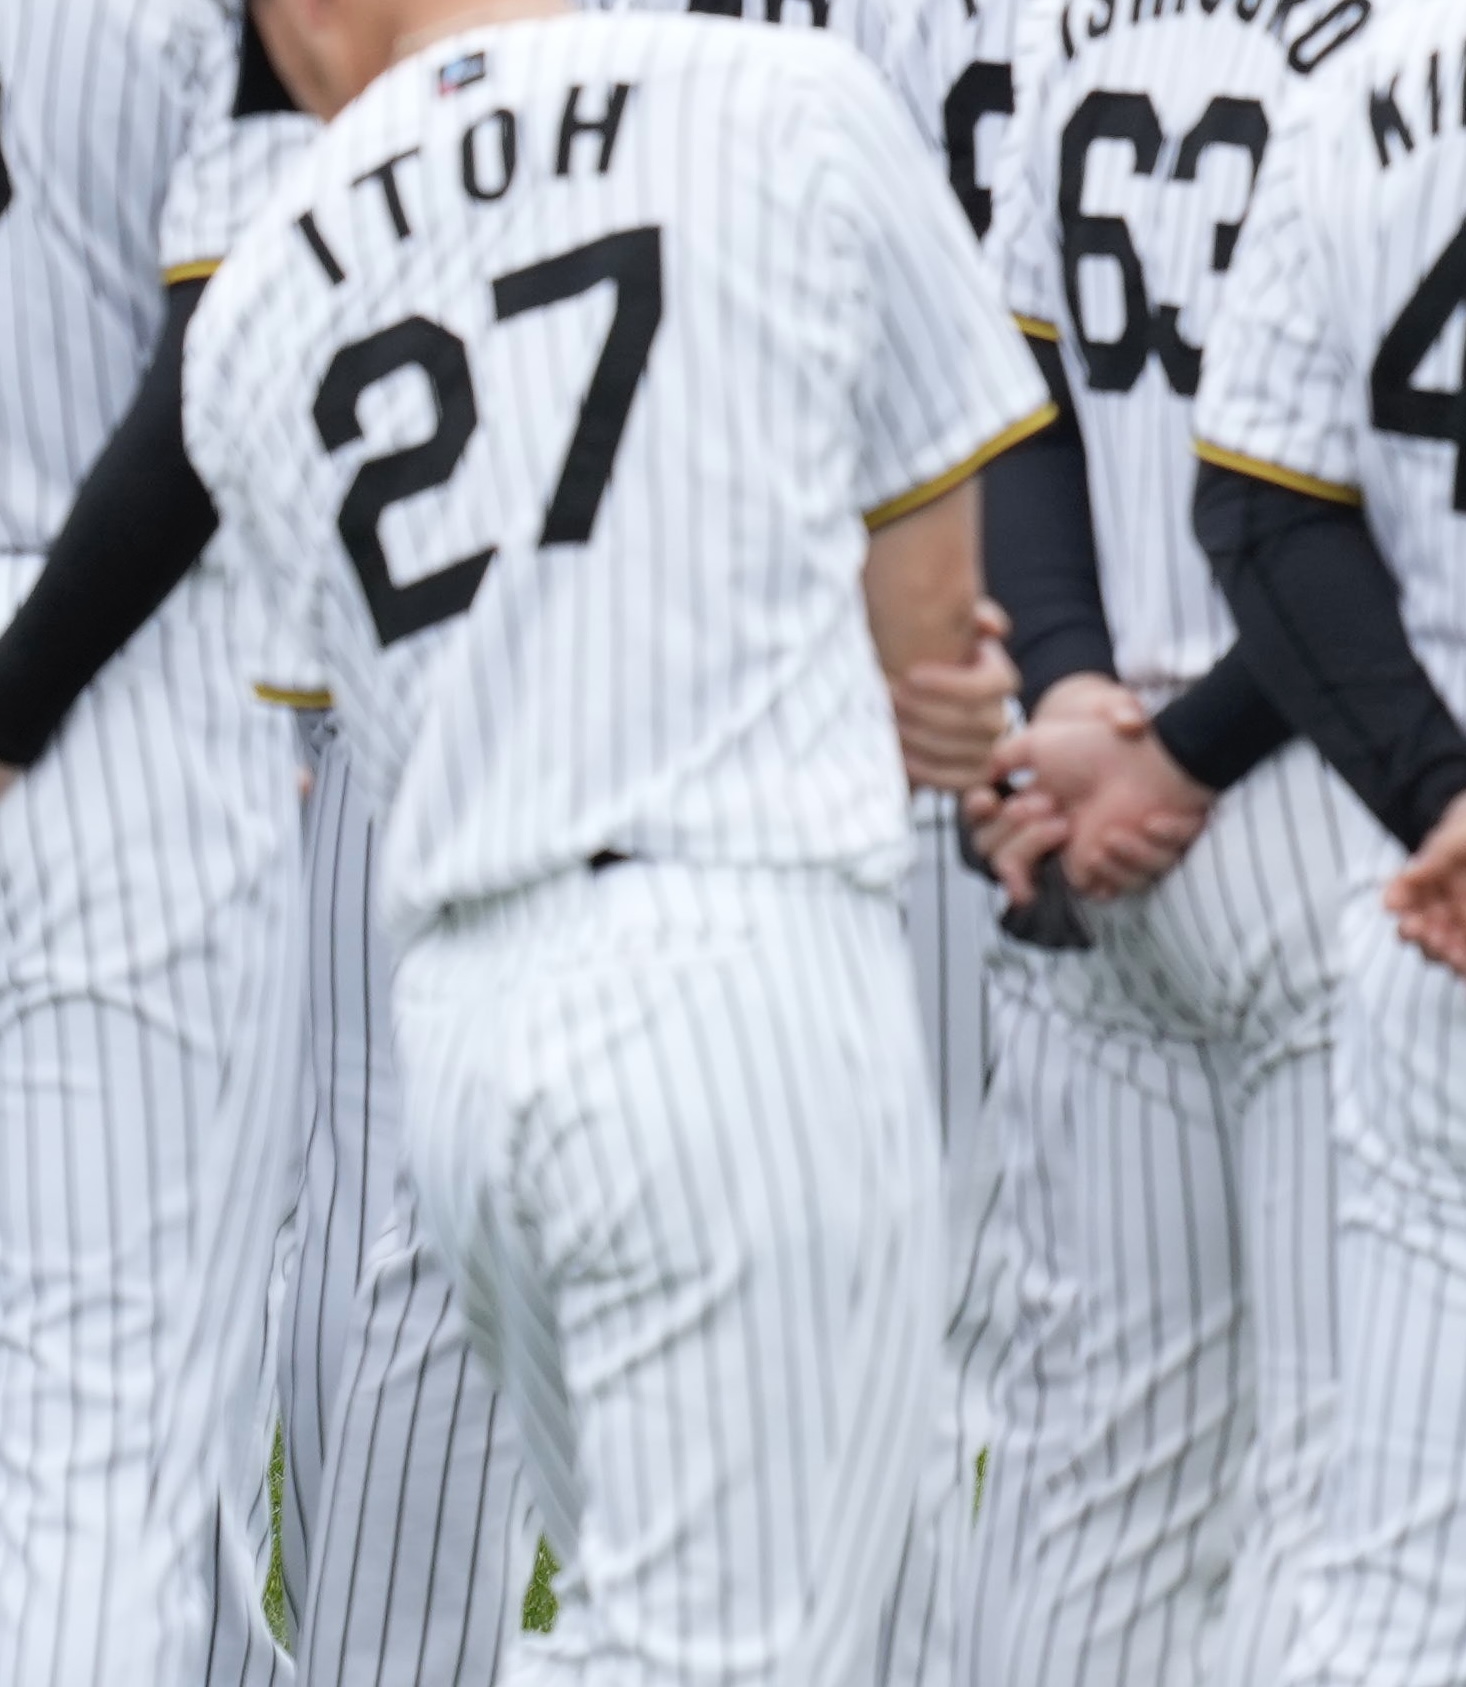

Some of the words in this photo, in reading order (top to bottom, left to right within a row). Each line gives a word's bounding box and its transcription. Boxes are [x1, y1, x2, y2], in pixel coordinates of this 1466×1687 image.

[292, 82, 631, 287] ITOH
[1056, 90, 1270, 397] 63
[312, 225, 662, 649] 27
